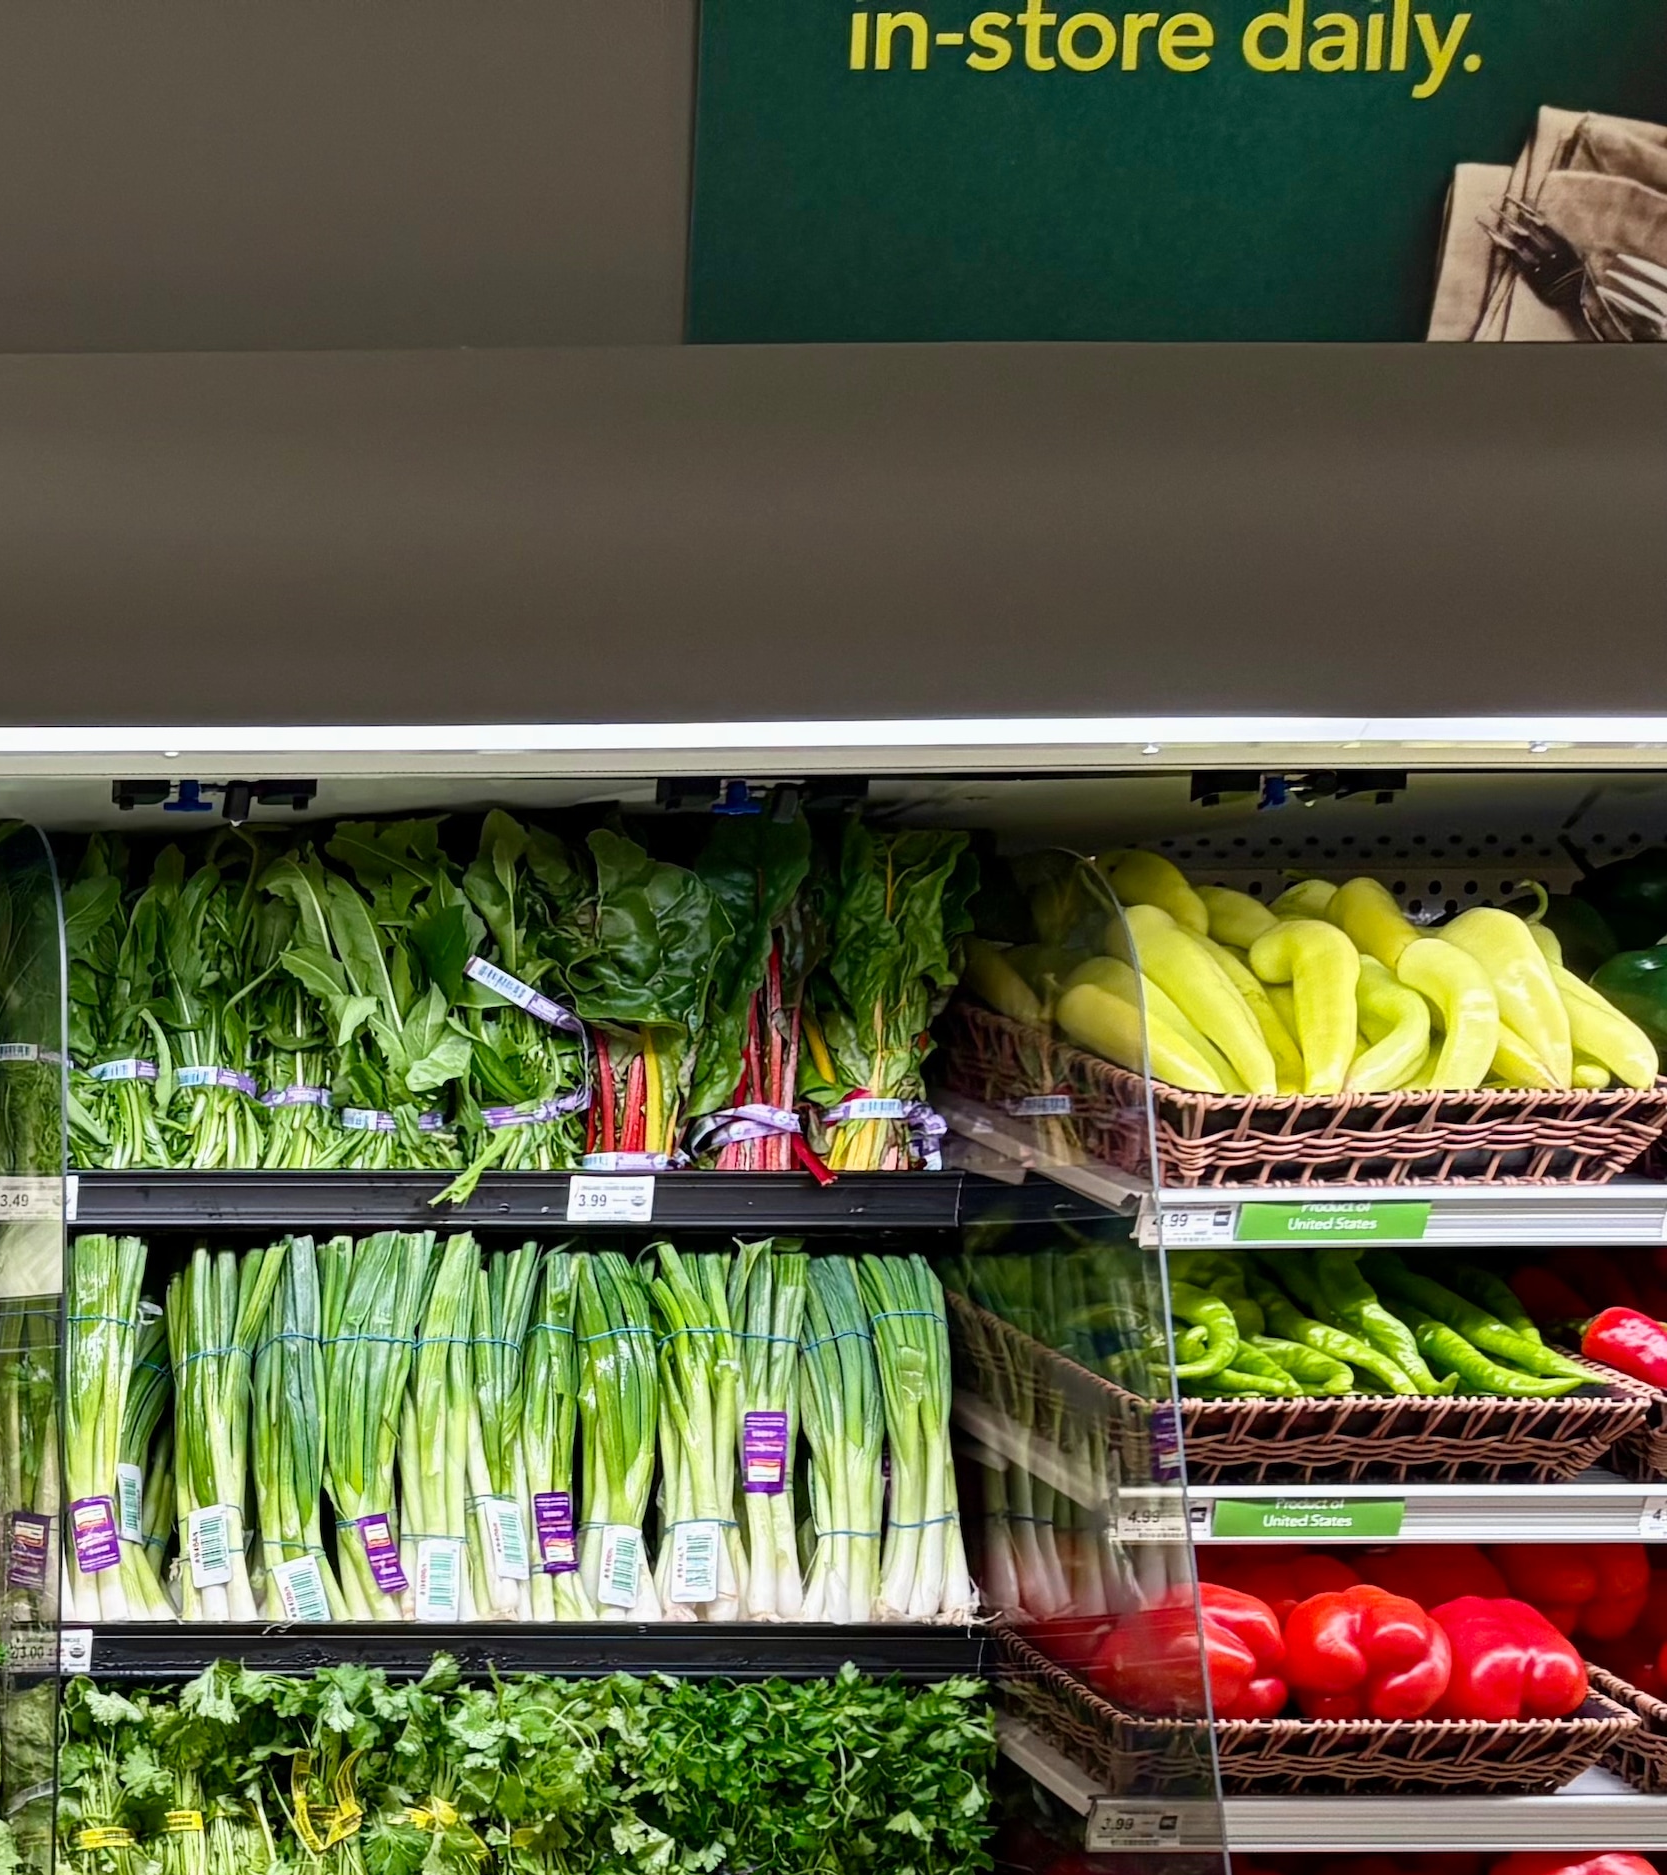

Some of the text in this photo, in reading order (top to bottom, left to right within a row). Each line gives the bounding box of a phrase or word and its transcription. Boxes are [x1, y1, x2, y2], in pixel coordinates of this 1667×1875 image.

[848, 0, 1482, 98] in-store daily.
[578, 1194, 608, 1207] 3.99
[1287, 1217, 1378, 1231] United States
[1262, 1514, 1353, 1528] United States
